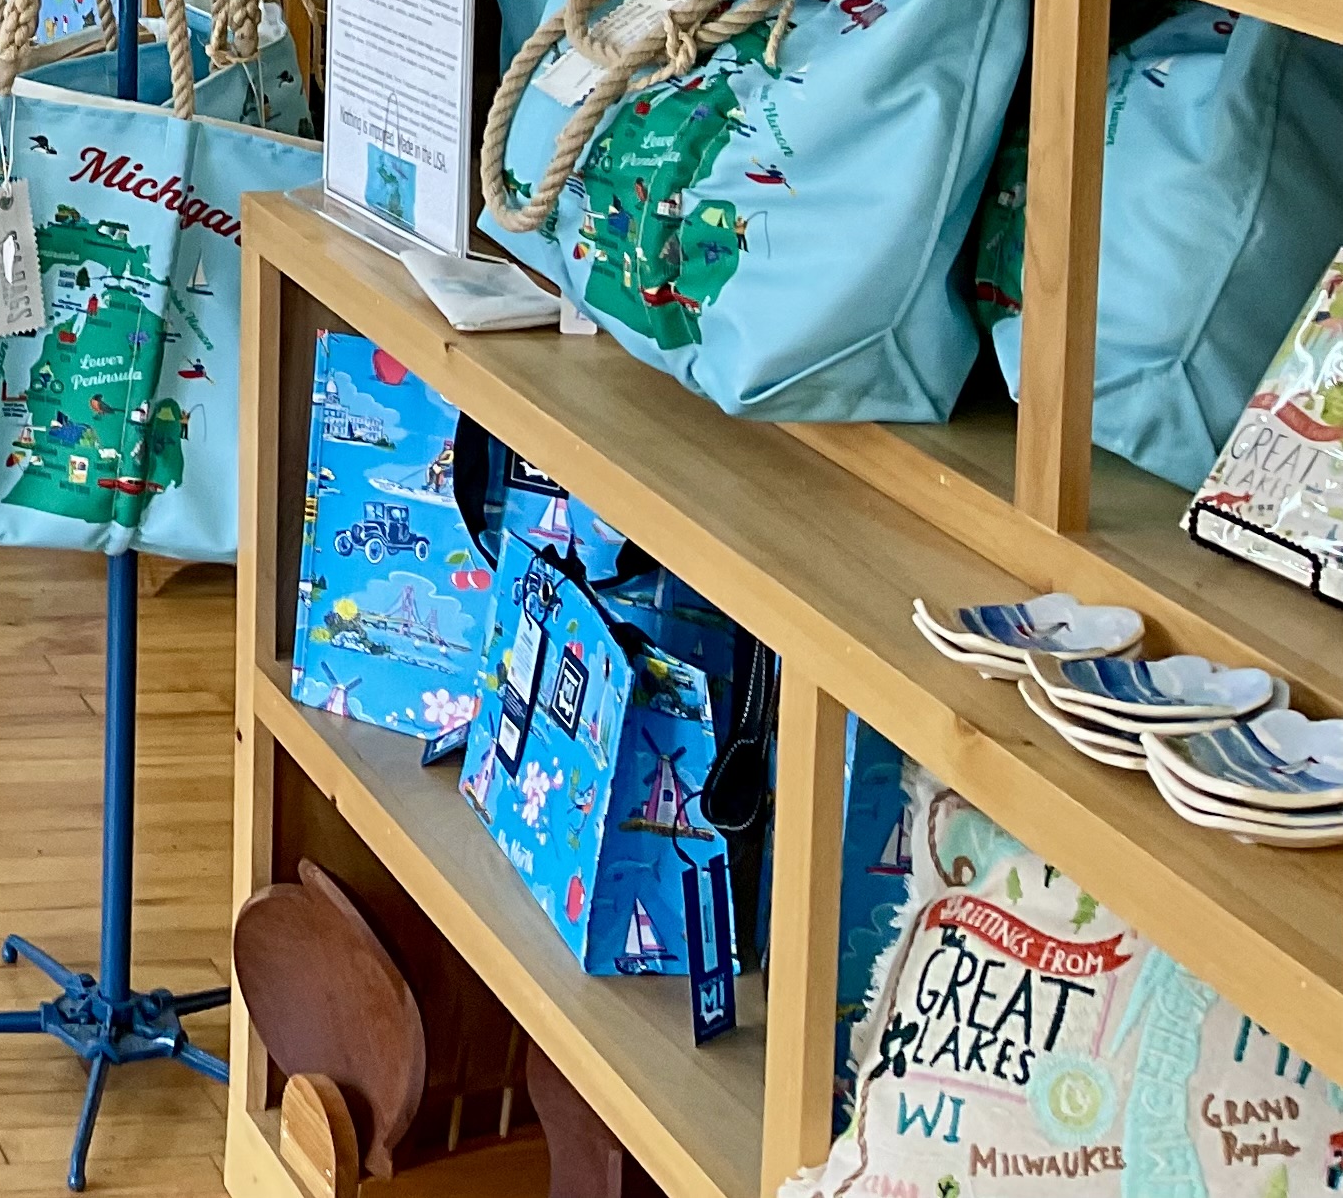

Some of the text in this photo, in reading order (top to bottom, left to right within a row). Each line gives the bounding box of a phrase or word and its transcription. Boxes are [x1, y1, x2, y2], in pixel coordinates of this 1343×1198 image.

[70, 369, 143, 391] Peninsula
[79, 353, 125, 370] Lower
[1231, 422, 1327, 485] GREAT
[939, 897, 1105, 975] GREETINGS FROM
[915, 946, 1096, 1052] GREAT
[911, 1016, 1037, 1086] LAKES
[896, 1090, 966, 1144] WI
[1201, 1093, 1300, 1129] GRAND
[968, 1142, 1128, 1180] MILWAUKEE
